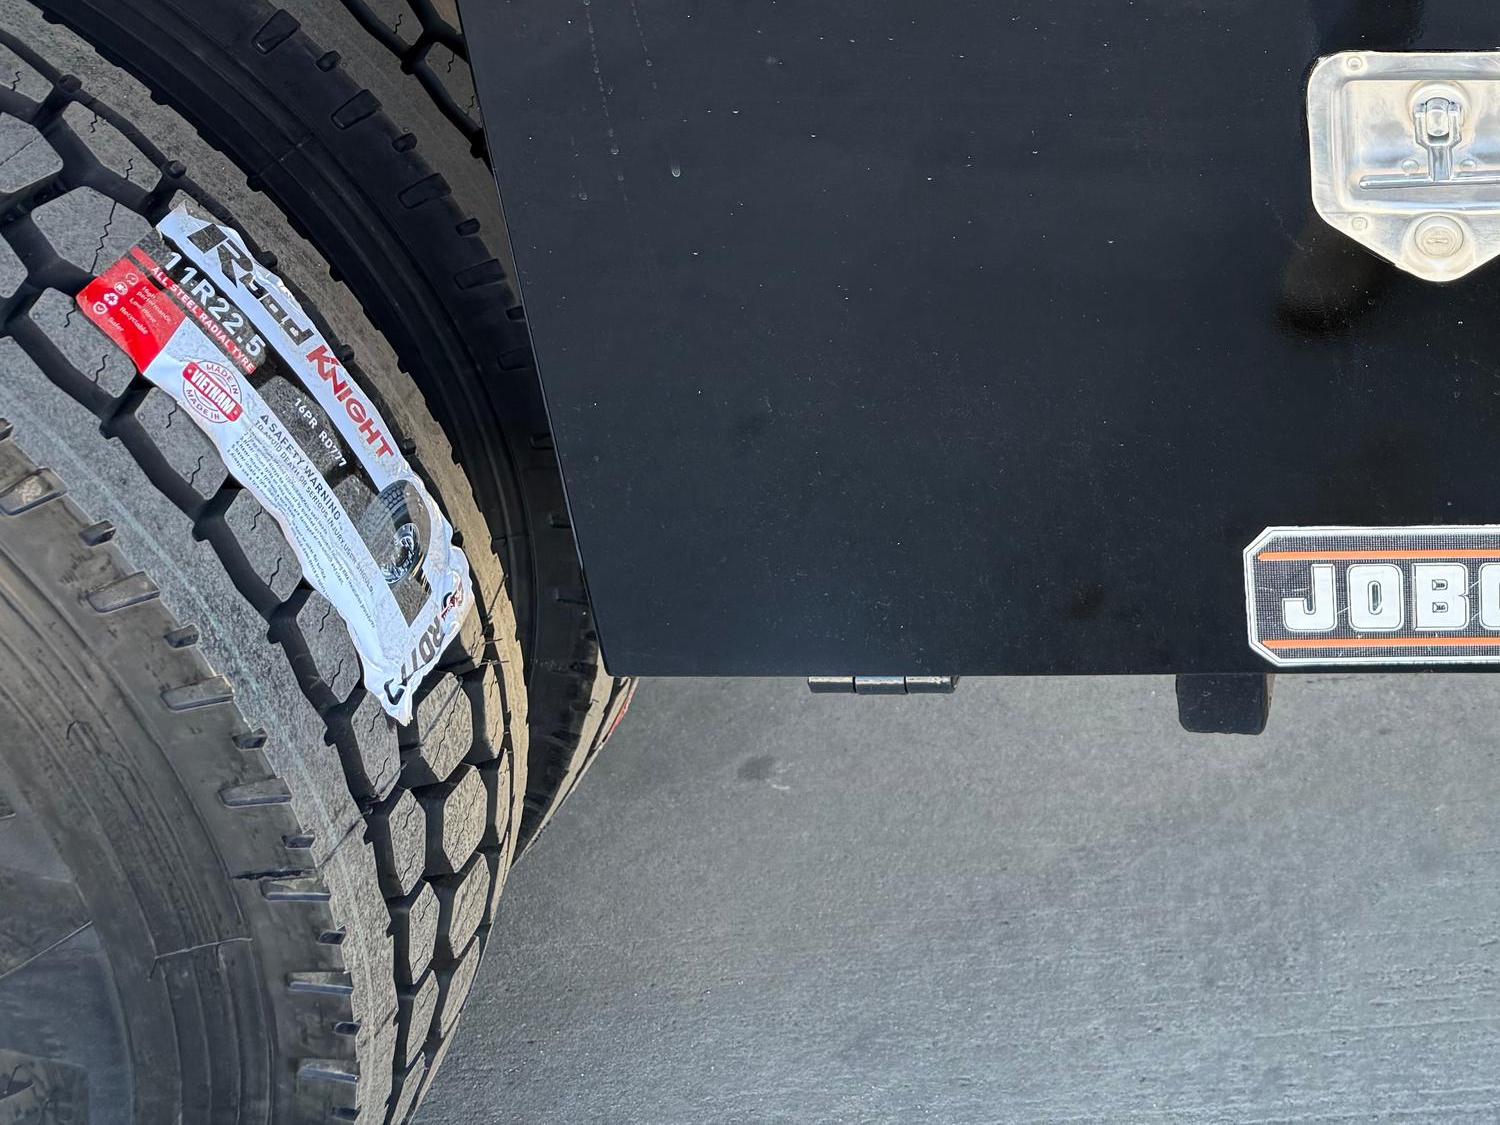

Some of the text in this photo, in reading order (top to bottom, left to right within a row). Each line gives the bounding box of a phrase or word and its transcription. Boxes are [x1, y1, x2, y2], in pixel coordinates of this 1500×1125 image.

[108, 317, 124, 332] Safer
[120, 306, 149, 335] Recyclable
[151, 267, 255, 372] ALL STEEL RADIAL TYRE
[165, 252, 267, 356] 11R22.5
[187, 390, 208, 414] MADE
[191, 369, 236, 414] VIETNAM
[207, 365, 238, 394] MADE IN
[306, 344, 394, 457] KNIGHT
[295, 397, 347, 466] 16PR RD777
[255, 420, 264, 431] TO
[280, 451, 299, 476] DEATH
[298, 475, 308, 487] OR
[306, 486, 329, 518] SERIOUS
[268, 423, 305, 464] SAFETY
[304, 465, 342, 520] WARNING
